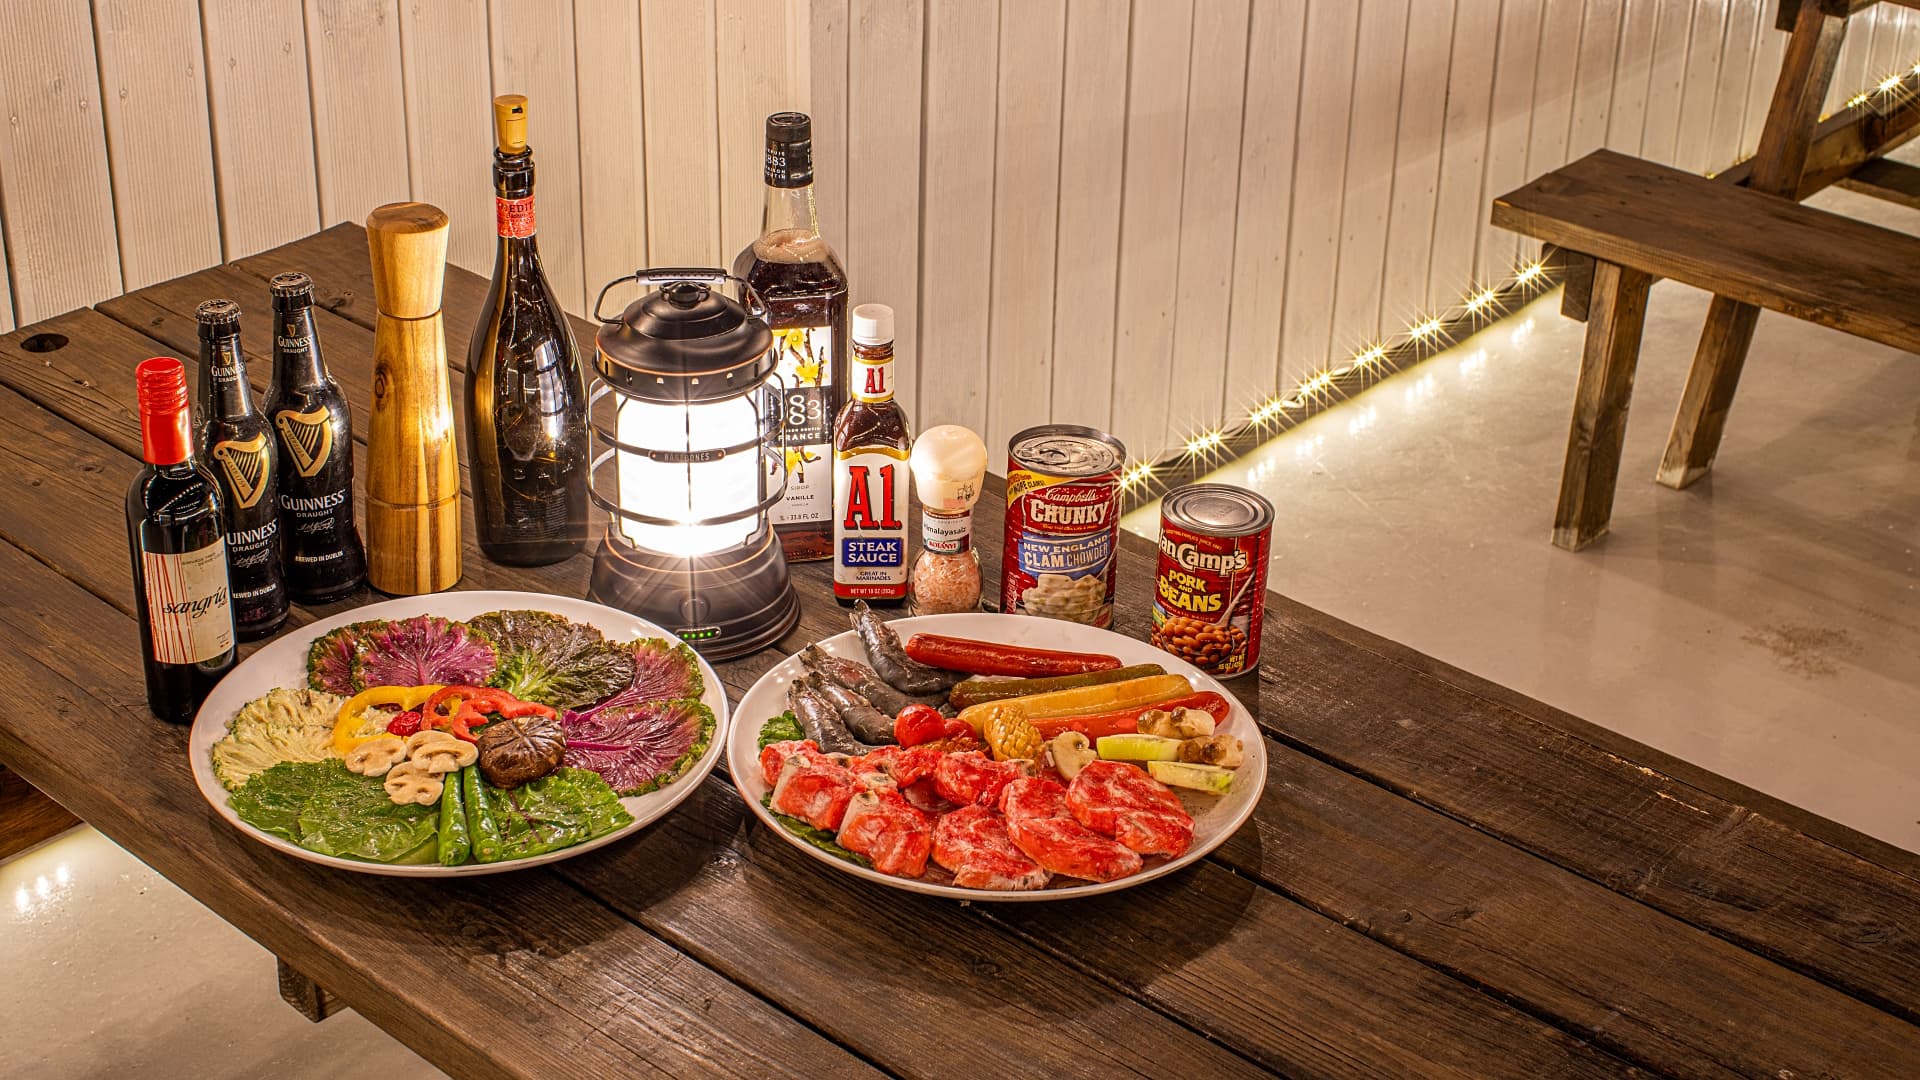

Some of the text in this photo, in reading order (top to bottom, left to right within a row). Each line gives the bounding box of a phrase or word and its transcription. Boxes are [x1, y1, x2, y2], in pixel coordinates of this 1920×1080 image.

[278, 335, 312, 348] GUINNESS
[281, 488, 346, 511] GUINNESS
[296, 508, 334, 518] DRAUGHT
[1030, 498, 1110, 525] CHUNKY
[226, 518, 277, 545] UINNESS
[232, 539, 269, 553] DRAUGHT
[848, 542, 897, 552] STEAK
[1023, 534, 1108, 553] NEW ENGLAND
[295, 554, 318, 563] BREWED
[325, 550, 344, 561] DUBLIN
[848, 553, 897, 563] SAUCE
[1024, 542, 1108, 568] CLAM CHOWDER
[1177, 543, 1247, 577] Camp's
[1169, 569, 1206, 593] PORK
[1177, 584, 1193, 593] AND
[252, 589, 259, 597] IN
[1160, 574, 1222, 613] BEANS
